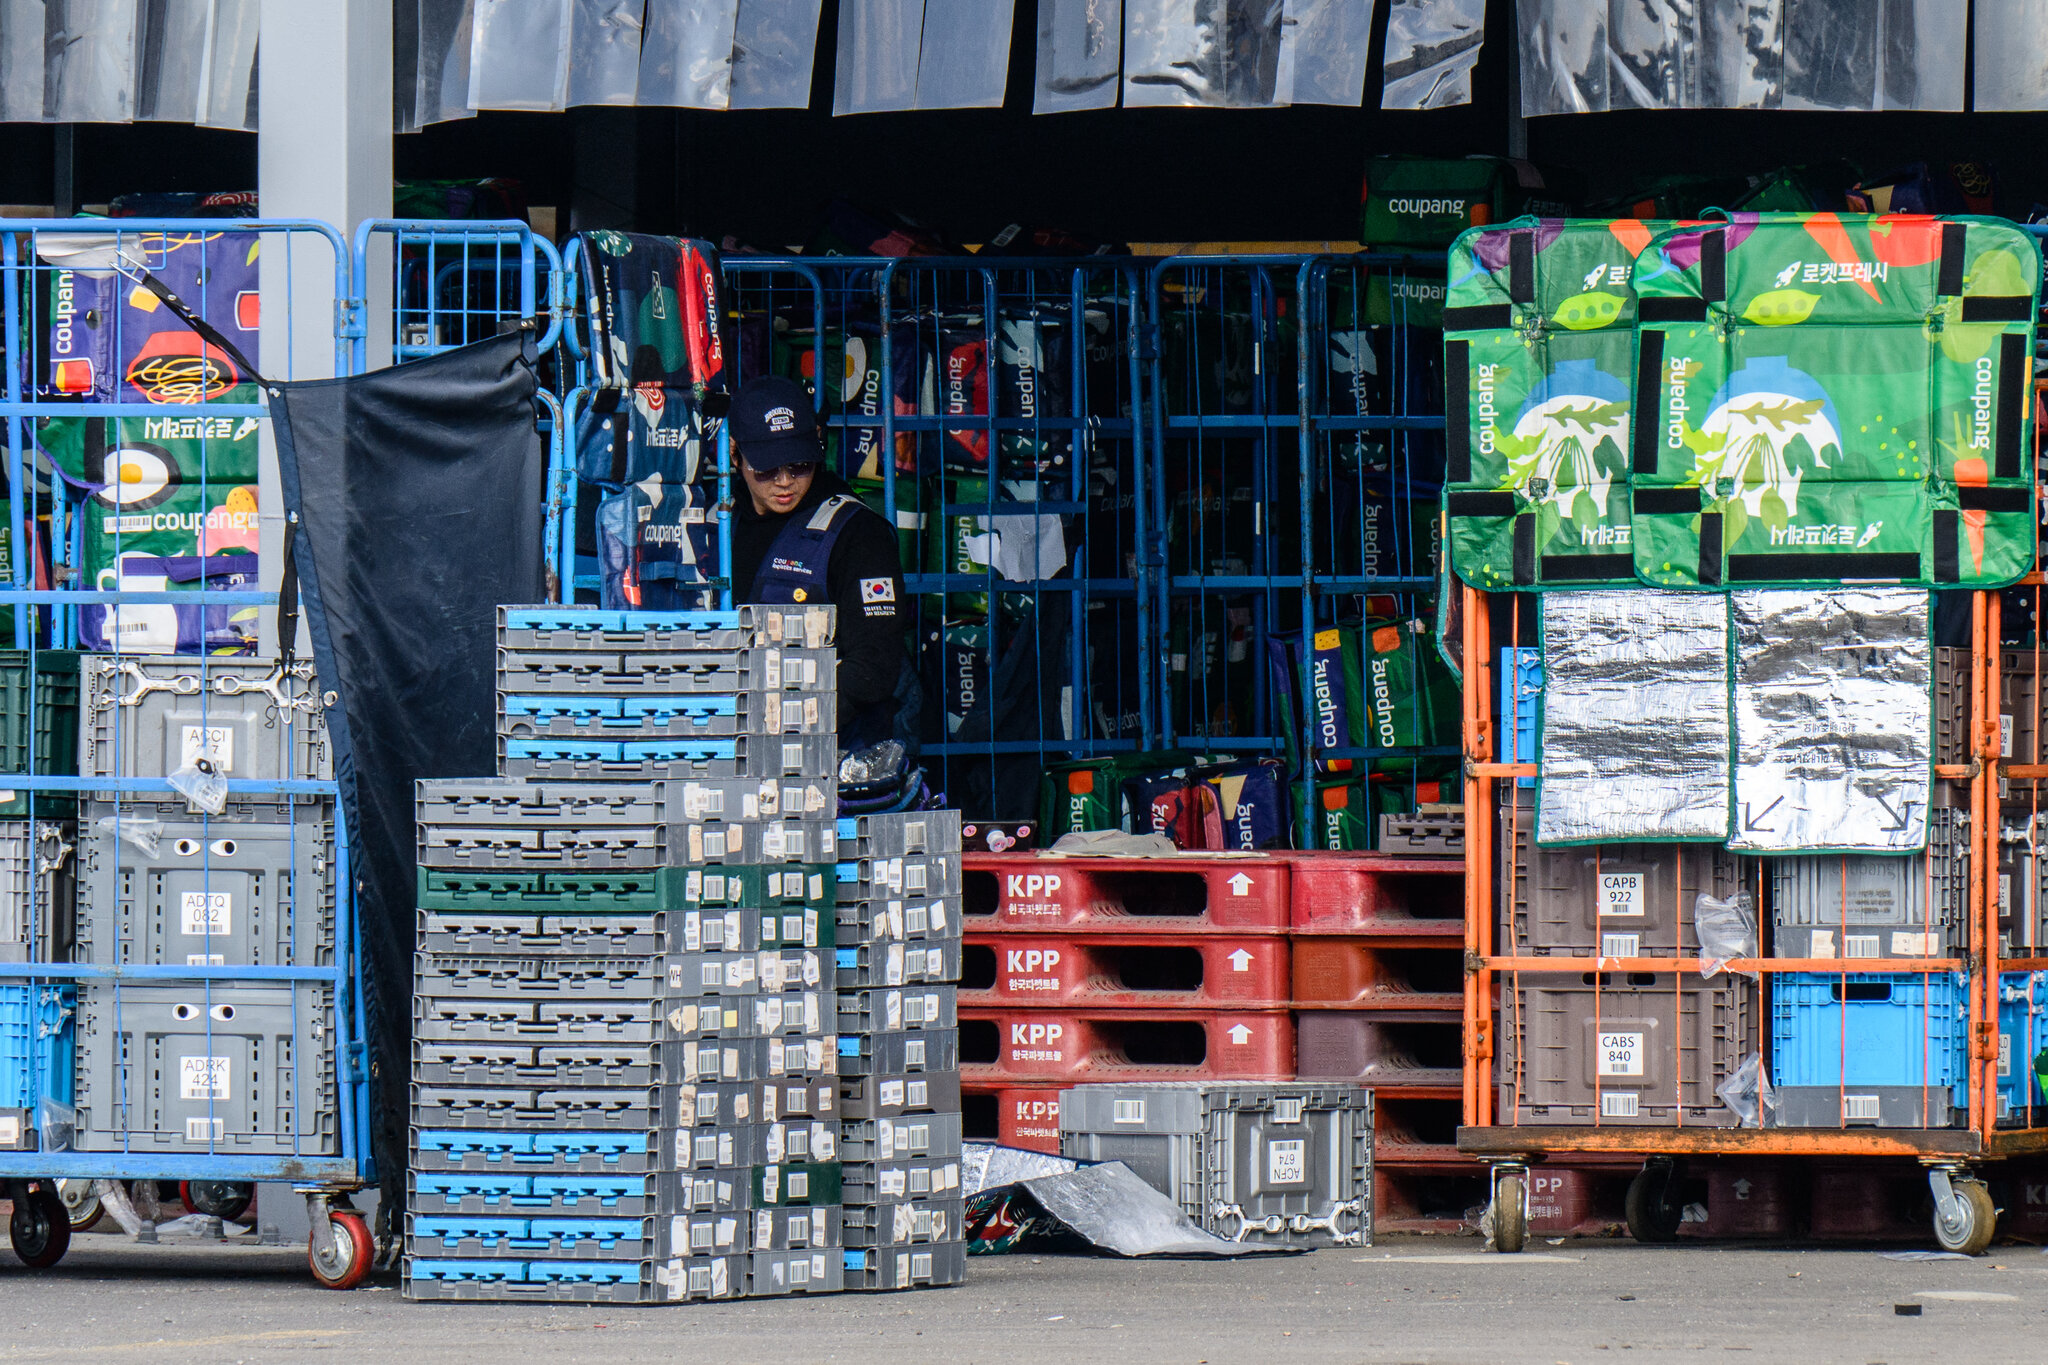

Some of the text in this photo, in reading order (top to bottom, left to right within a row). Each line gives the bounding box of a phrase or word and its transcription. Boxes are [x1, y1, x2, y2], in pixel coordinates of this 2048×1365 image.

[1389, 199, 1465, 219] coupang
[1801, 262, 1888, 284] 로켓프레시
[1392, 283, 1446, 304] coupan
[704, 272, 722, 360] coupang
[1016, 346, 1036, 418] coupan
[854, 369, 880, 455] coupng
[1478, 363, 1499, 454] coupang
[1668, 356, 1692, 449] coupang
[1969, 357, 1992, 450] coupang
[144, 416, 235, 439] 로켓프레시
[153, 513, 248, 536] coupang
[1770, 524, 1857, 545] 로켓프레시
[644, 525, 682, 549] coupang
[1364, 504, 1383, 580] oupang
[773, 557, 803, 568] coupang
[1314, 658, 1337, 748] coupang
[1371, 658, 1395, 748] coupang
[1007, 874, 1062, 898] KPP
[1604, 876, 1637, 889] CAPB
[187, 894, 225, 908] ADTQ
[1609, 891, 1632, 903] 922
[193, 909, 219, 922] 082
[1007, 950, 1060, 974] KPP
[1011, 1023, 1063, 1046] KPP
[1602, 1036, 1635, 1048] CABS
[185, 1059, 226, 1072] ADRK
[1608, 1050, 1631, 1062] 840
[192, 1074, 218, 1086] 424
[1017, 1101, 1059, 1121] KPP
[1279, 1153, 1296, 1165] 674
[1274, 1167, 1301, 1180] ACFN
[1522, 1177, 1563, 1193] PP
